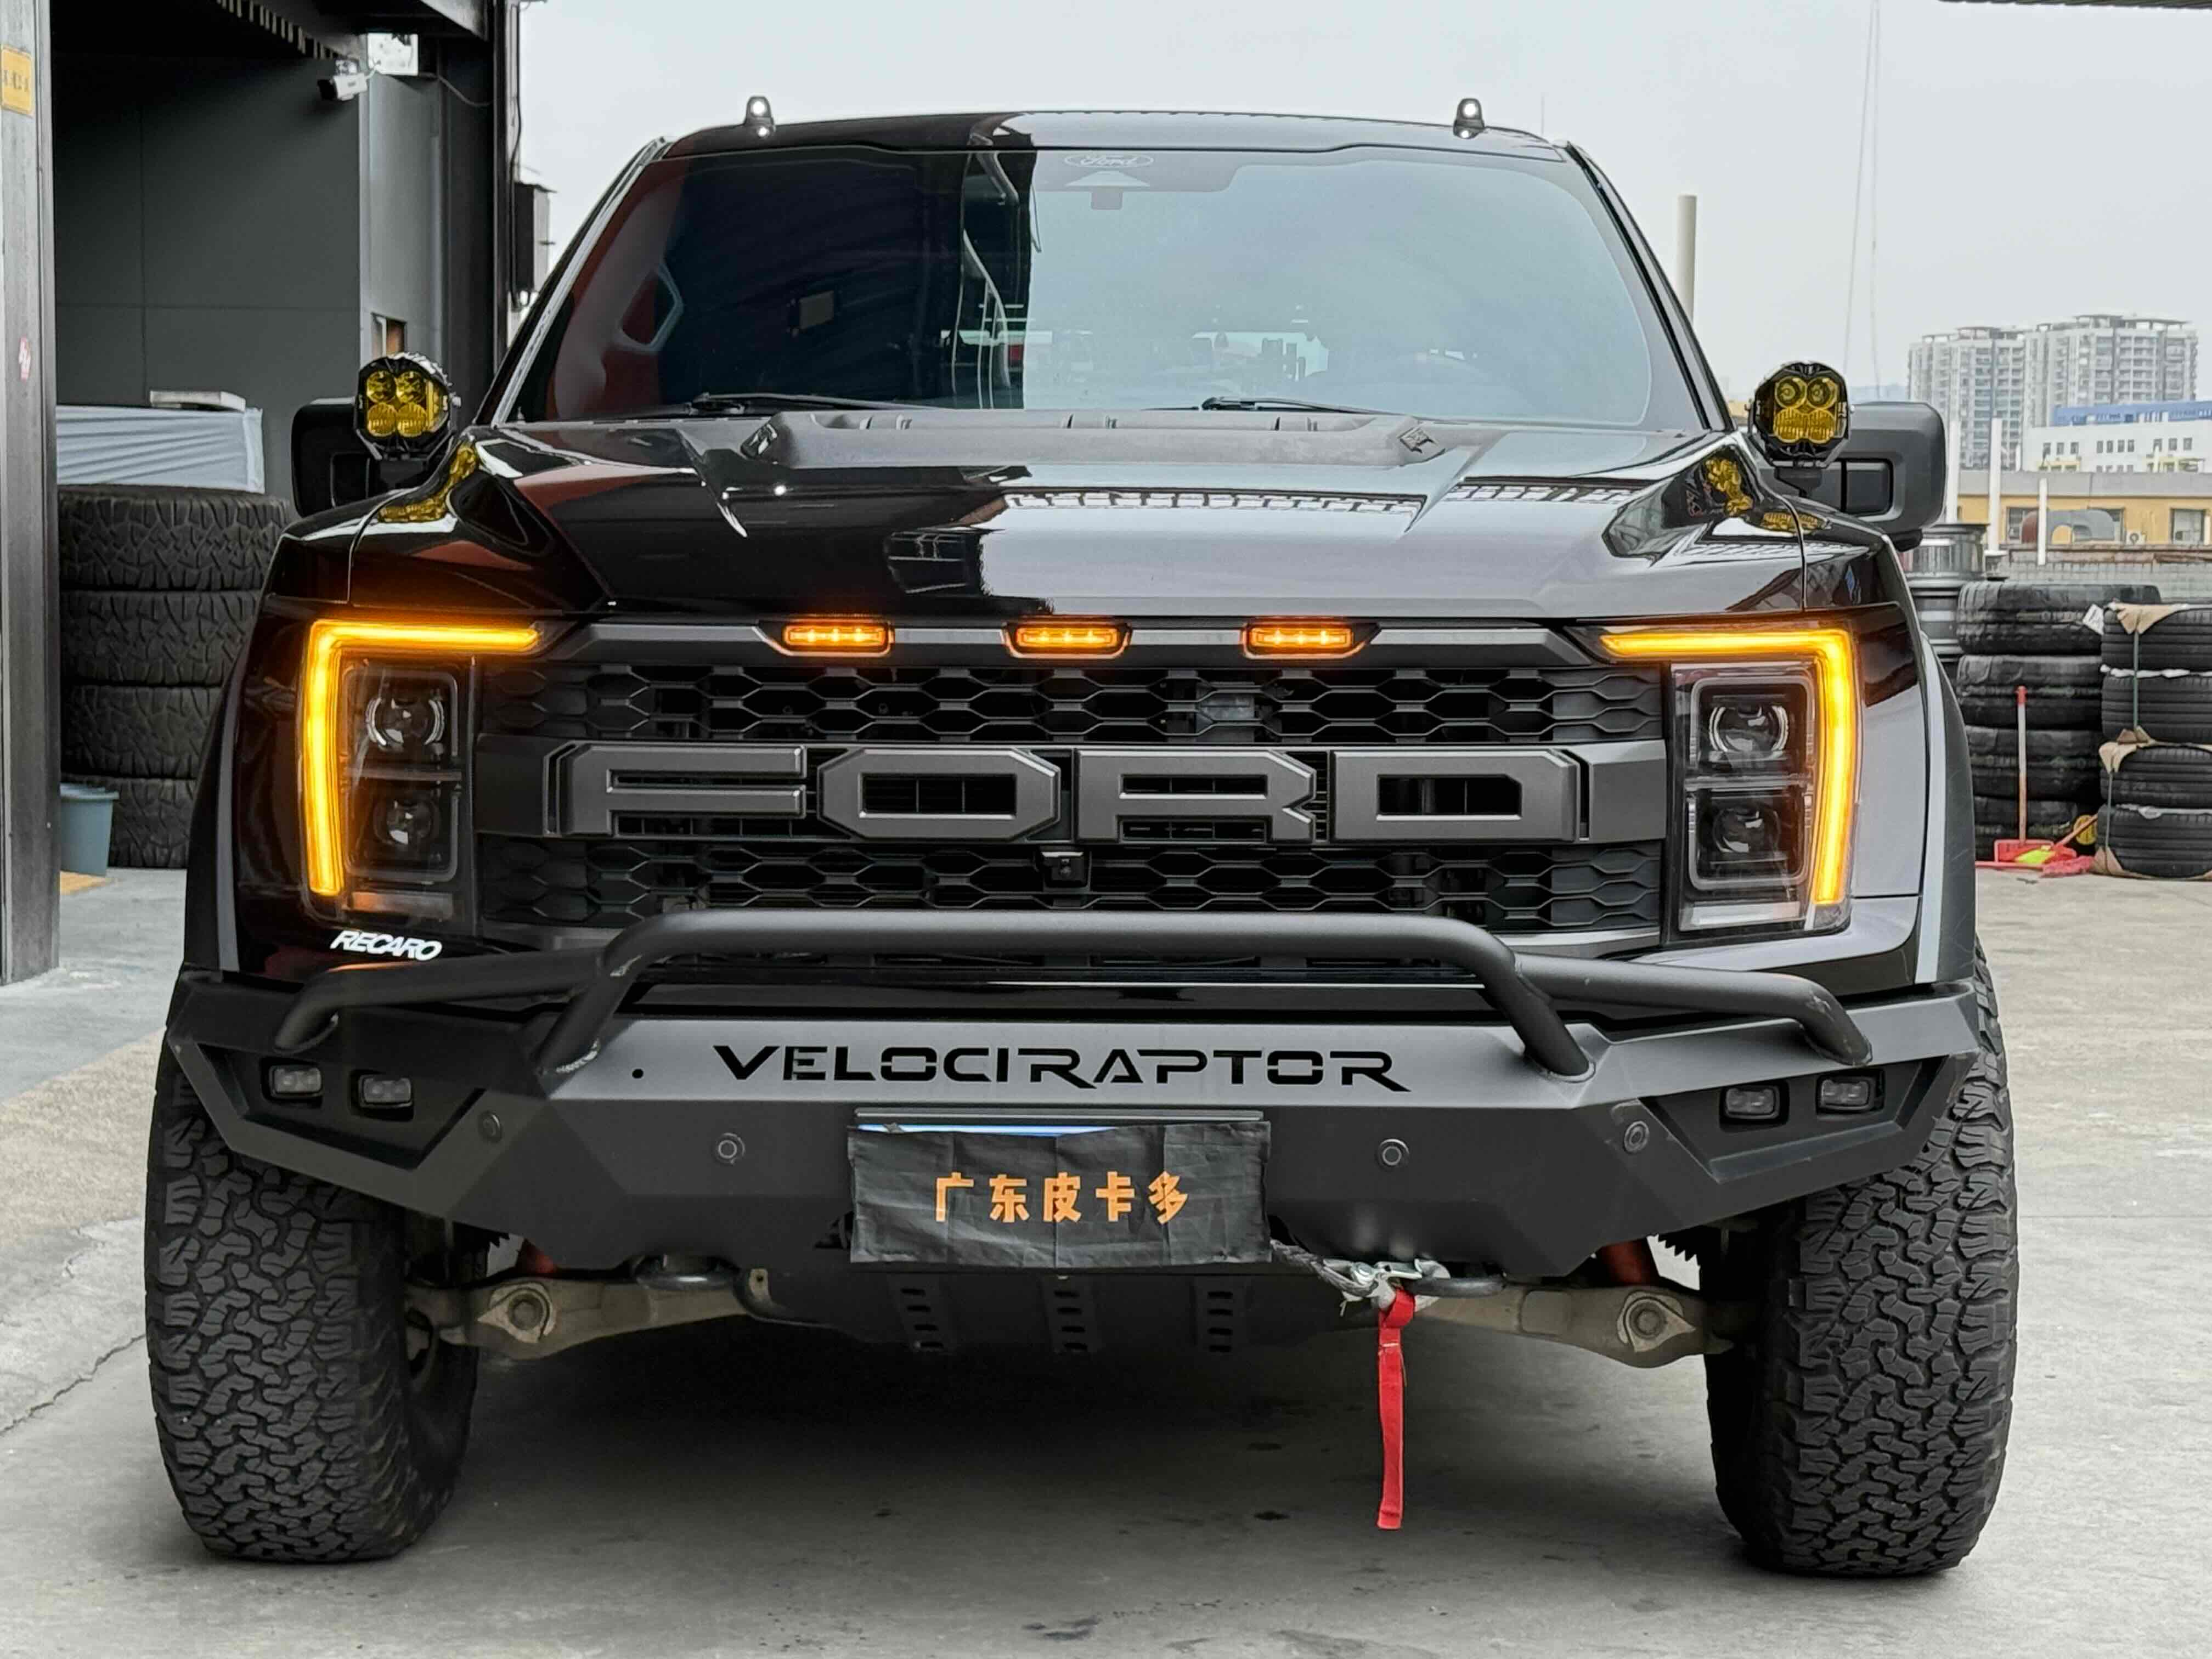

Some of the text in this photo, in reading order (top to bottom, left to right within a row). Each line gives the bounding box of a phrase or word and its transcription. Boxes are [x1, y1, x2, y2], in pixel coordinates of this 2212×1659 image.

[1080, 150, 1138, 166] Ford
[556, 743, 1578, 843] FORD
[330, 930, 442, 961] RECARO
[712, 1045, 1412, 1092] VELOCIRAPTOR
[935, 1171, 1189, 1224] 广东皮卡多
